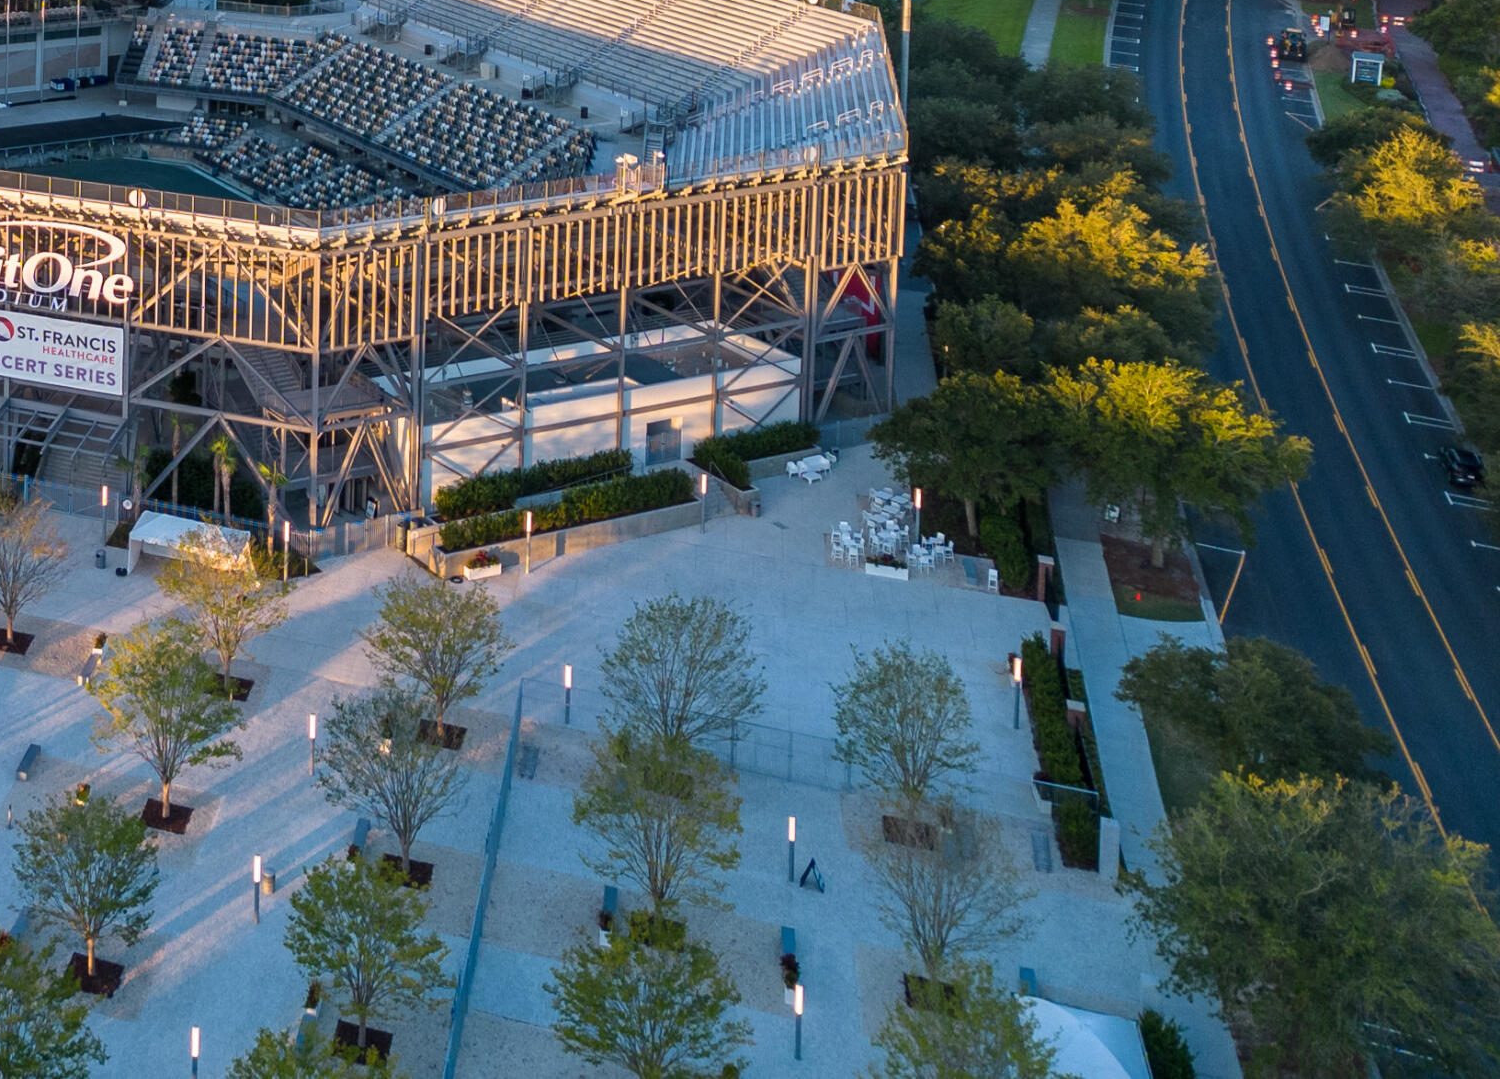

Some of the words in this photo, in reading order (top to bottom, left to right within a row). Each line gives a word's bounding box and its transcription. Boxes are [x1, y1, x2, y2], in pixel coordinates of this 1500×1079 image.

[17, 327, 39, 342] ST.
[43, 329, 117, 354] FRANCIS
[42, 346, 115, 365] HEALTHCARE
[54, 363, 117, 387] SERIES
